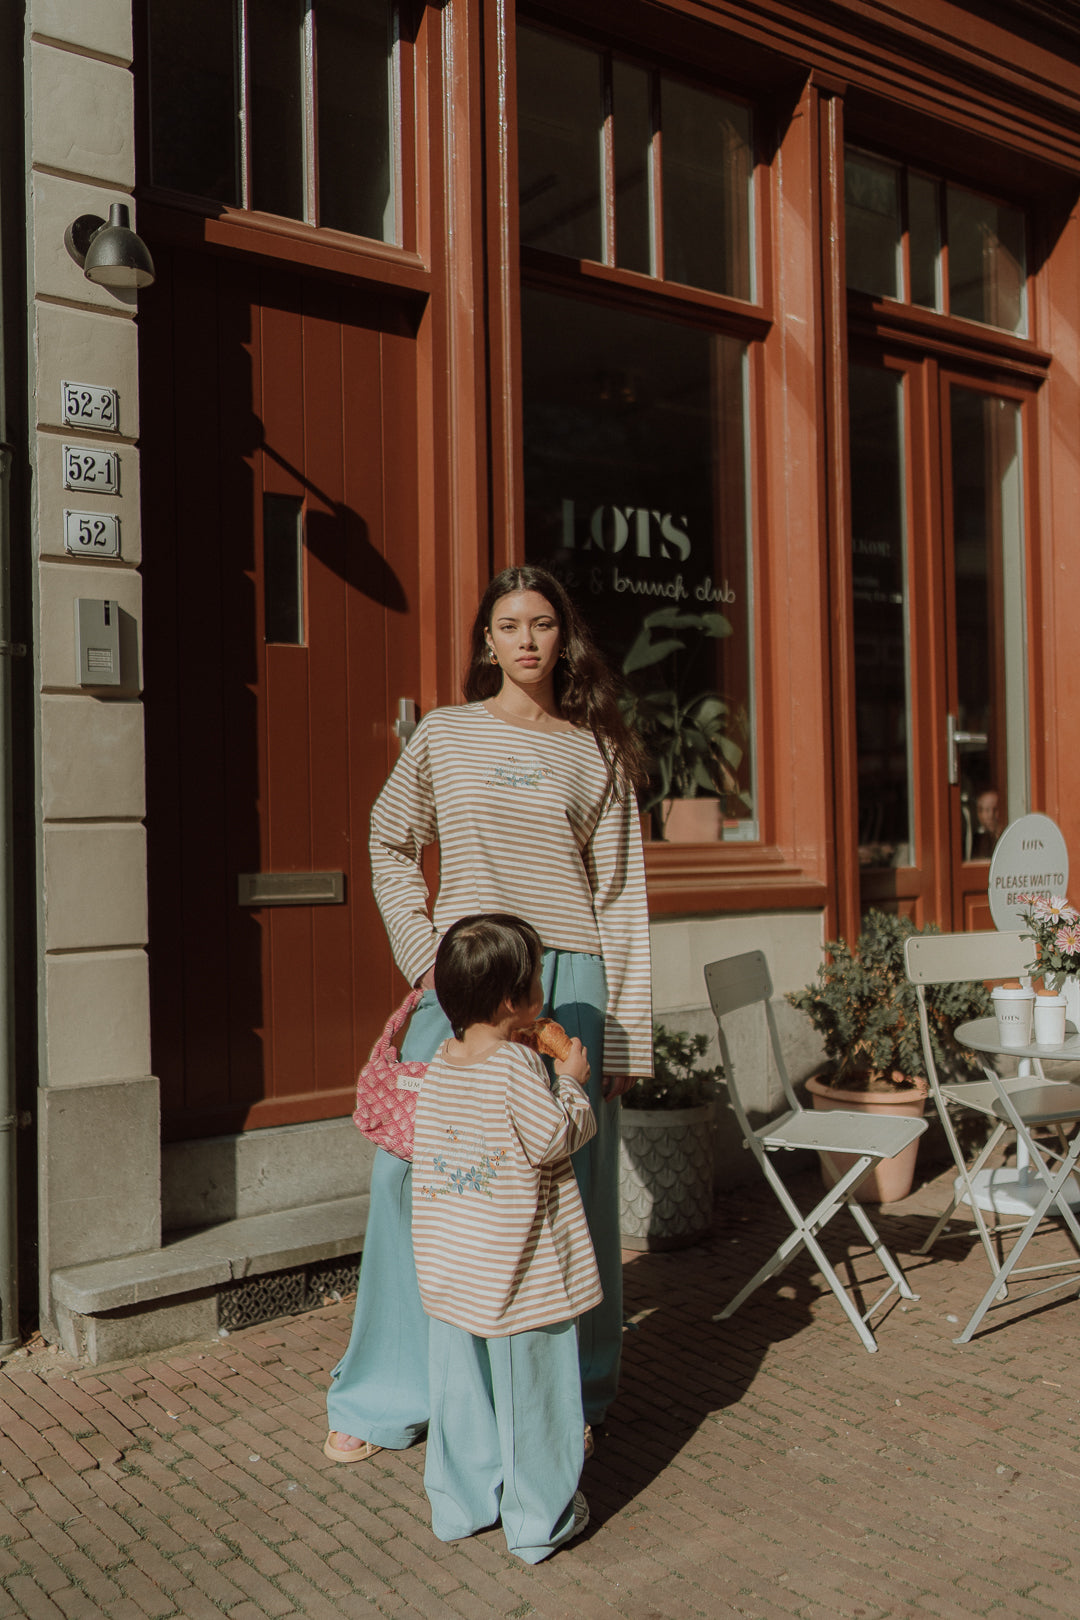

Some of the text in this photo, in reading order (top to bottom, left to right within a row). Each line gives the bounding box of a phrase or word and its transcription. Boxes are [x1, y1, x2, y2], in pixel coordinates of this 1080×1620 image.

[68, 390, 112, 420] 52-2
[69, 454, 113, 485] 52-1
[79, 519, 106, 546] 52
[563, 500, 692, 562] LOTS
[614, 567, 689, 601] brunch
[696, 577, 736, 604] club
[995, 873, 1064, 889] PLEASE WAIT TO
[1007, 893, 1017, 905] BE
